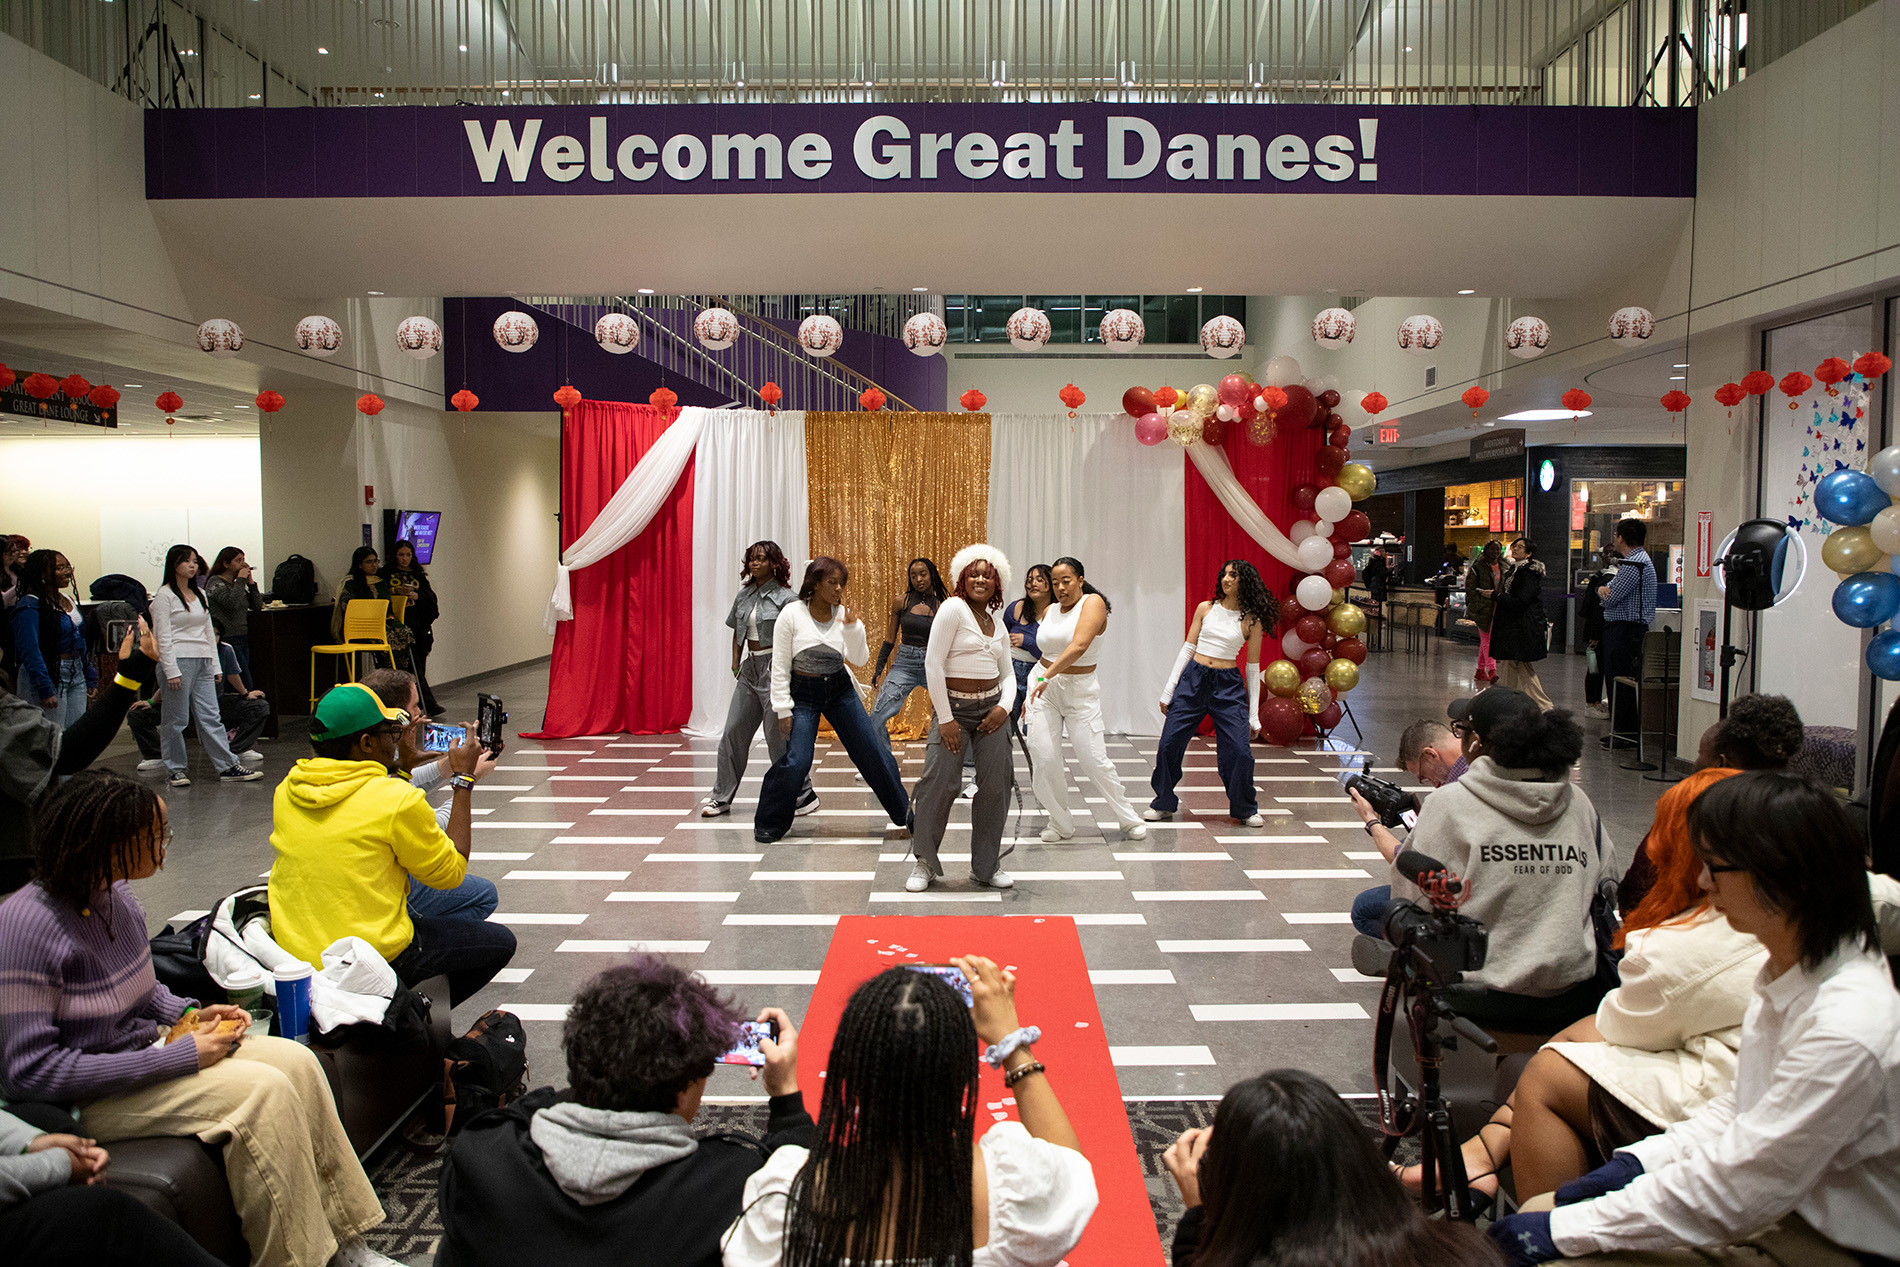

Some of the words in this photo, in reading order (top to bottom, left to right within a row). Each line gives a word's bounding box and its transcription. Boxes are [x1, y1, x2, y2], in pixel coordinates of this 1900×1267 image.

[463, 116, 833, 183] Welcome
[852, 115, 1084, 182] Great
[1107, 116, 1379, 182] Danes!
[13, 399, 37, 414] GREAT
[60, 406, 89, 422] LOUNGE
[1380, 428, 1398, 443] EXIT
[1514, 865, 1536, 875] FEAR
[1540, 865, 1550, 875] OF
[1555, 865, 1573, 875] GOD
[1382, 985, 1396, 1014] Canon
